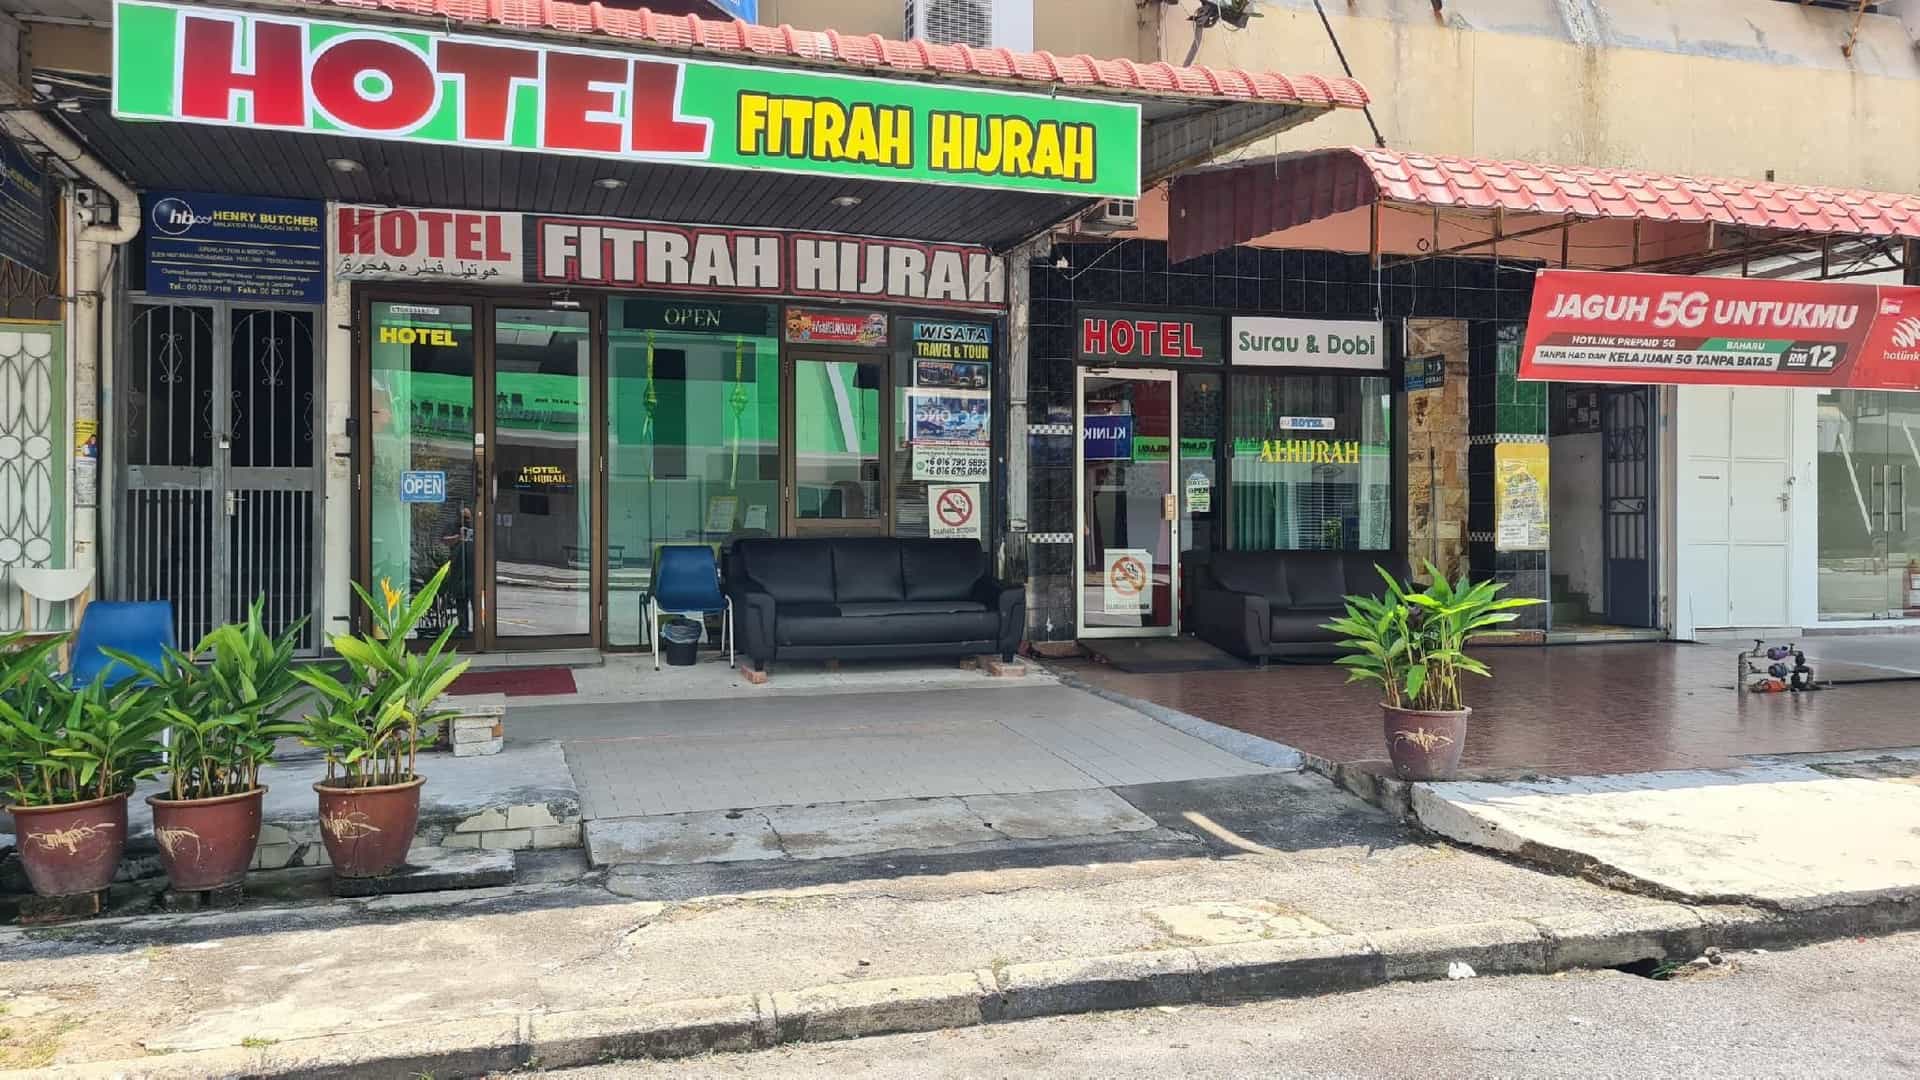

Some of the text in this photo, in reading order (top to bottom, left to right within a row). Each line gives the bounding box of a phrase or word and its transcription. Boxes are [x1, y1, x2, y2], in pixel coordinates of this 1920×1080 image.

[180, 14, 710, 153] HOTEL
[738, 91, 1096, 182] FITRAH HIJRAH
[213, 210, 318, 226] HENRY BUTCHER
[338, 207, 511, 261] HOTEL
[542, 222, 1005, 302] FITRAH HIJRAH
[664, 308, 721, 327] OPEN
[1546, 293, 1649, 322] JAGUH
[1653, 291, 1709, 328] 5G
[1714, 302, 1858, 330] UNTUKMU
[379, 326, 458, 347] HOTEL
[919, 324, 988, 342] WISATA
[1083, 318, 1203, 358] HOTEL
[1238, 331, 1375, 355] Surau & Dobi
[1571, 335, 1676, 348] HOTLINK PREPAID 5G
[917, 342, 989, 359] TRAVEL & TOUR
[1726, 341, 1765, 350] BAHARU
[1883, 350, 1920, 361] hotlink
[1539, 350, 1773, 367] TANPA HAD DAN KELAJUAN 5G TANPA BATAS
[1788, 344, 1836, 368] RM 12
[404, 478, 442, 495] OPEN
